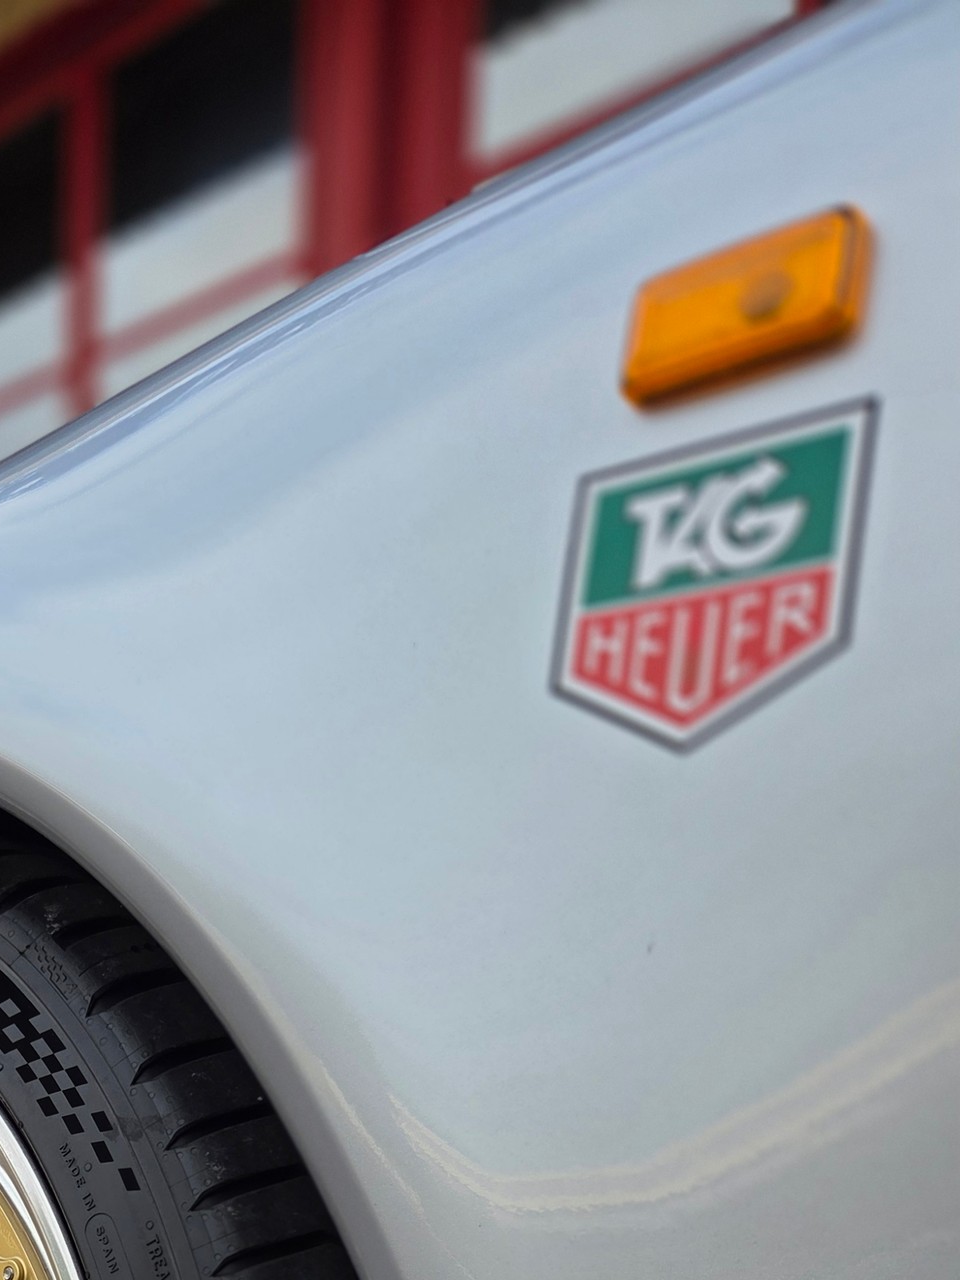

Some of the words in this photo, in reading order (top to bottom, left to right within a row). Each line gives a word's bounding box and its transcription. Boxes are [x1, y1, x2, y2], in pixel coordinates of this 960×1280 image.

[625, 454, 809, 592] TAG
[581, 577, 820, 714] HEUER
[58, 1142, 87, 1189] MADE
[81, 1192, 98, 1212] IN
[95, 1224, 121, 1275] SPAIN
